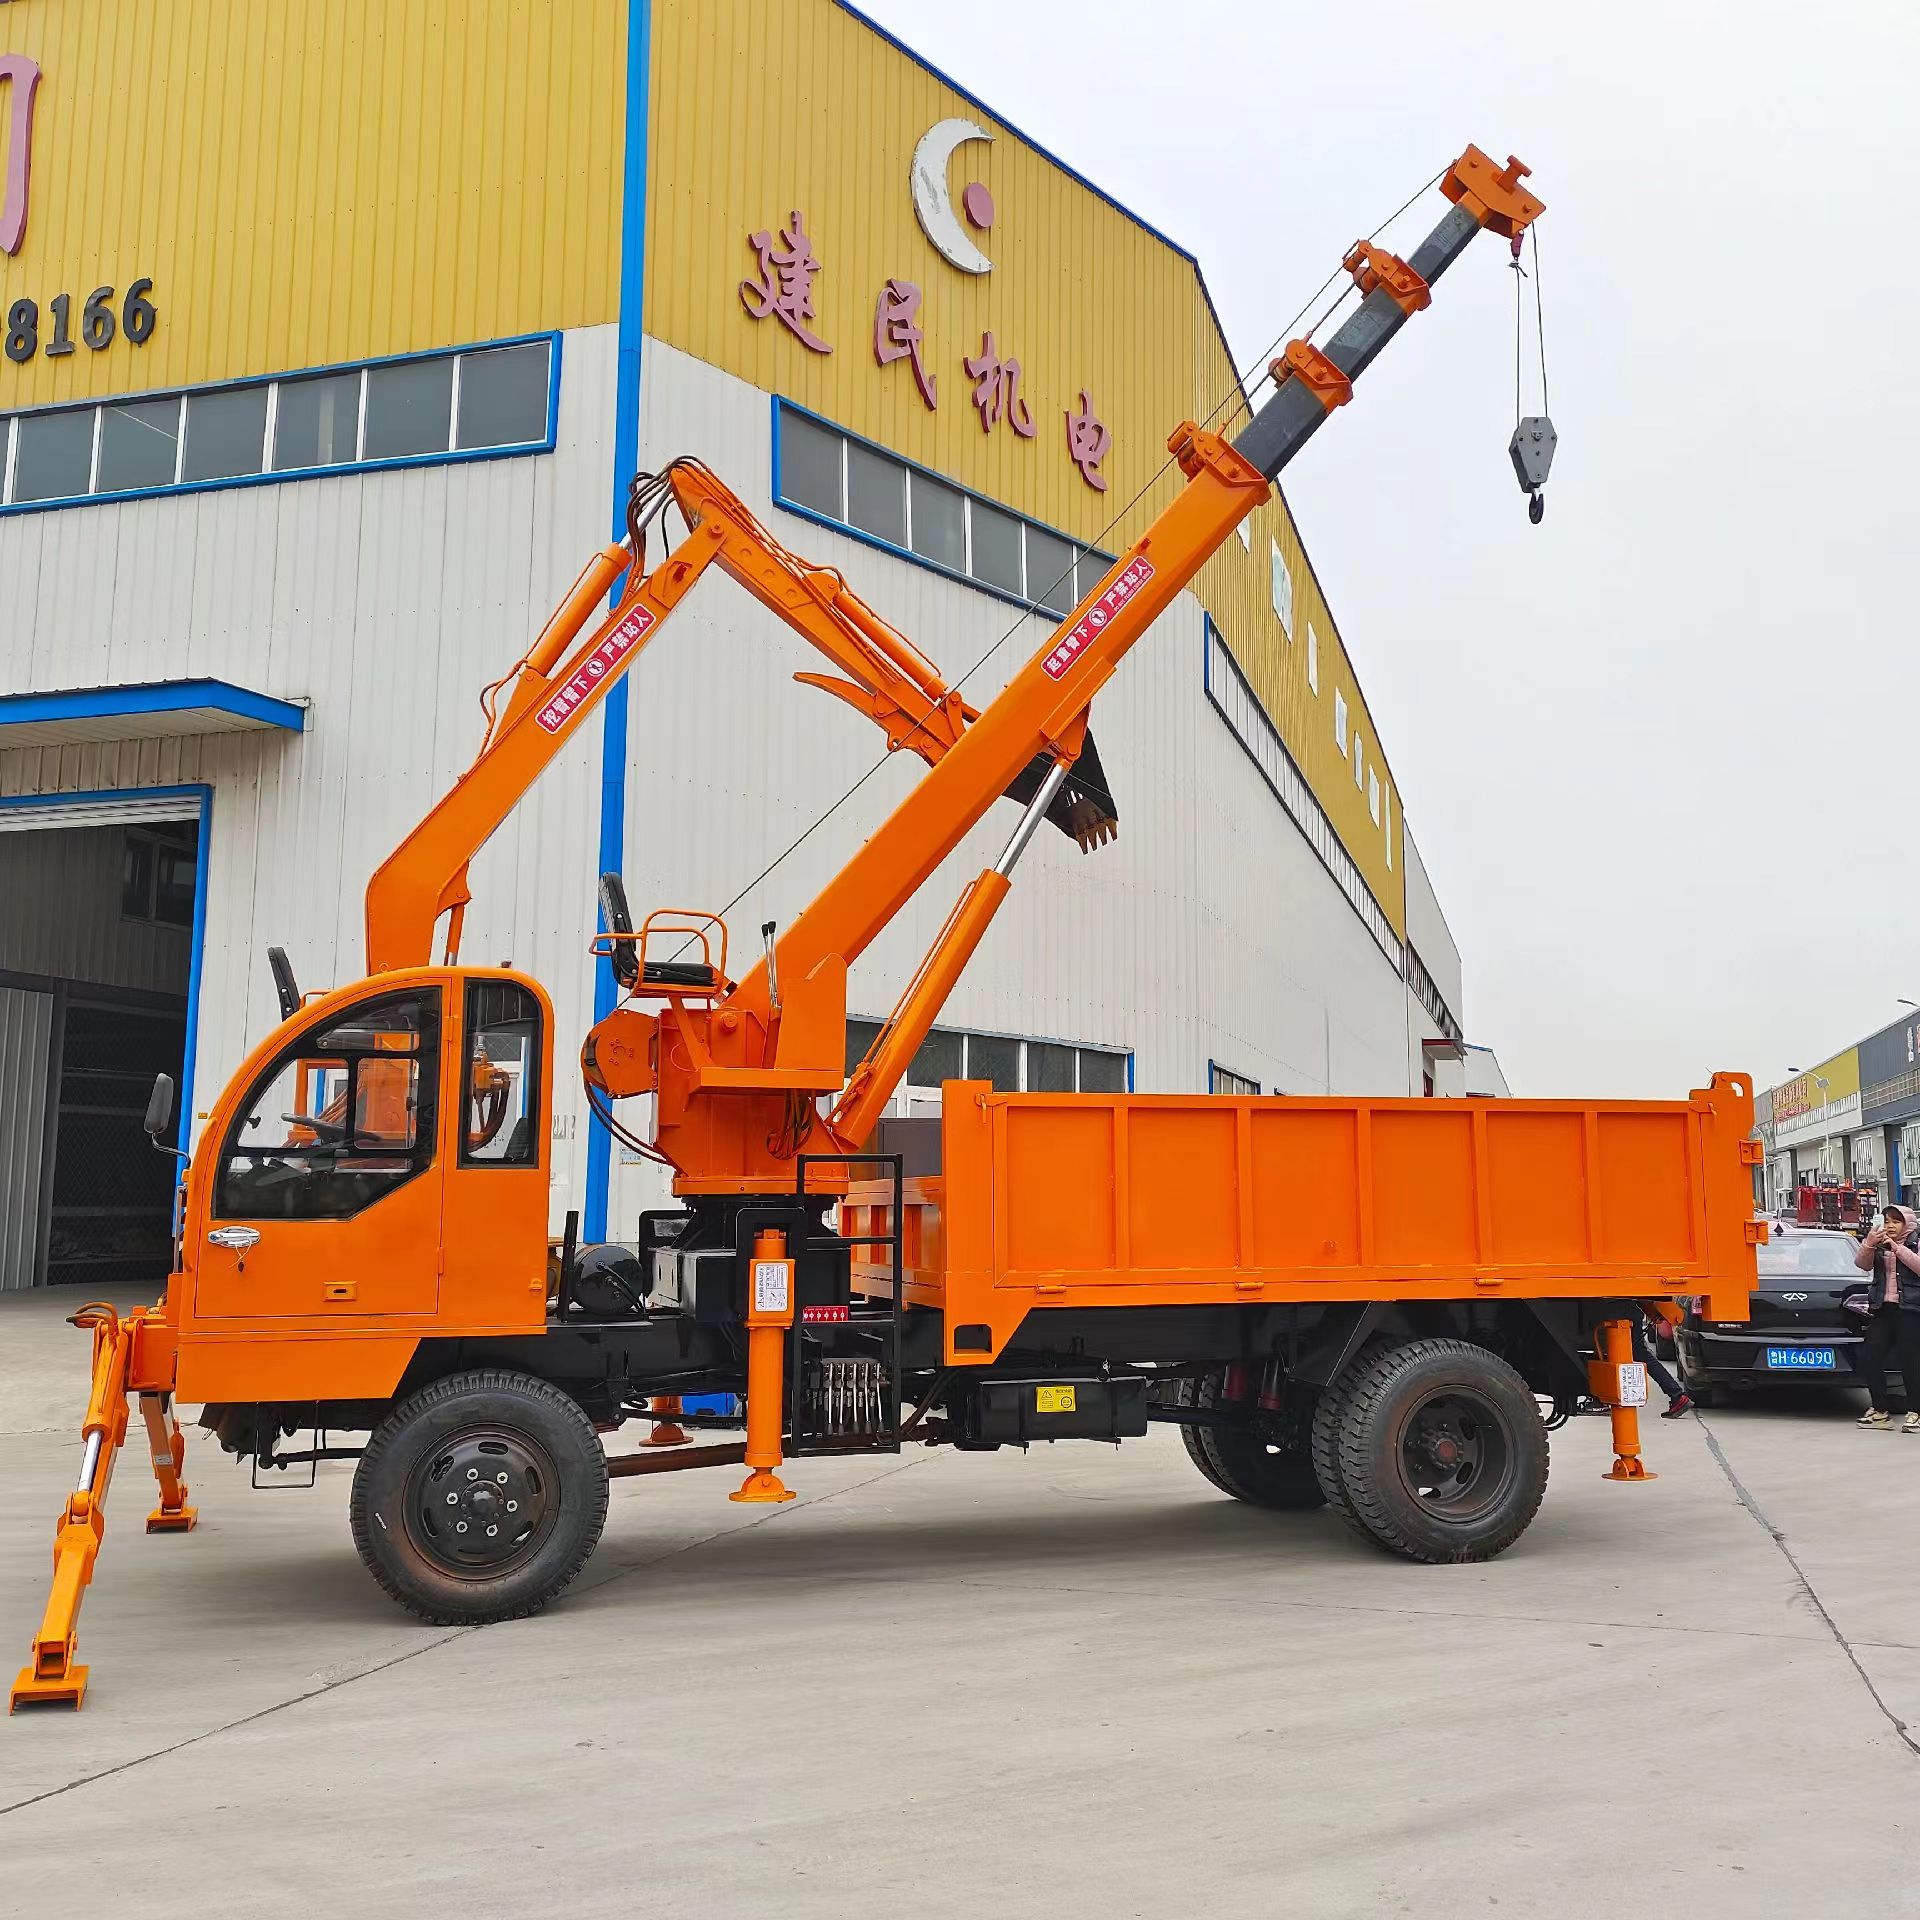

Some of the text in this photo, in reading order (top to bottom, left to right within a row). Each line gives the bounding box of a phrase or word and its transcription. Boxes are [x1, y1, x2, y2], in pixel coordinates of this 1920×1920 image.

[0, 277, 157, 361] 8166
[738, 210, 1110, 492] 建民机电
[1103, 562, 1148, 608] 严禁站人
[601, 612, 650, 661] 严禁站人
